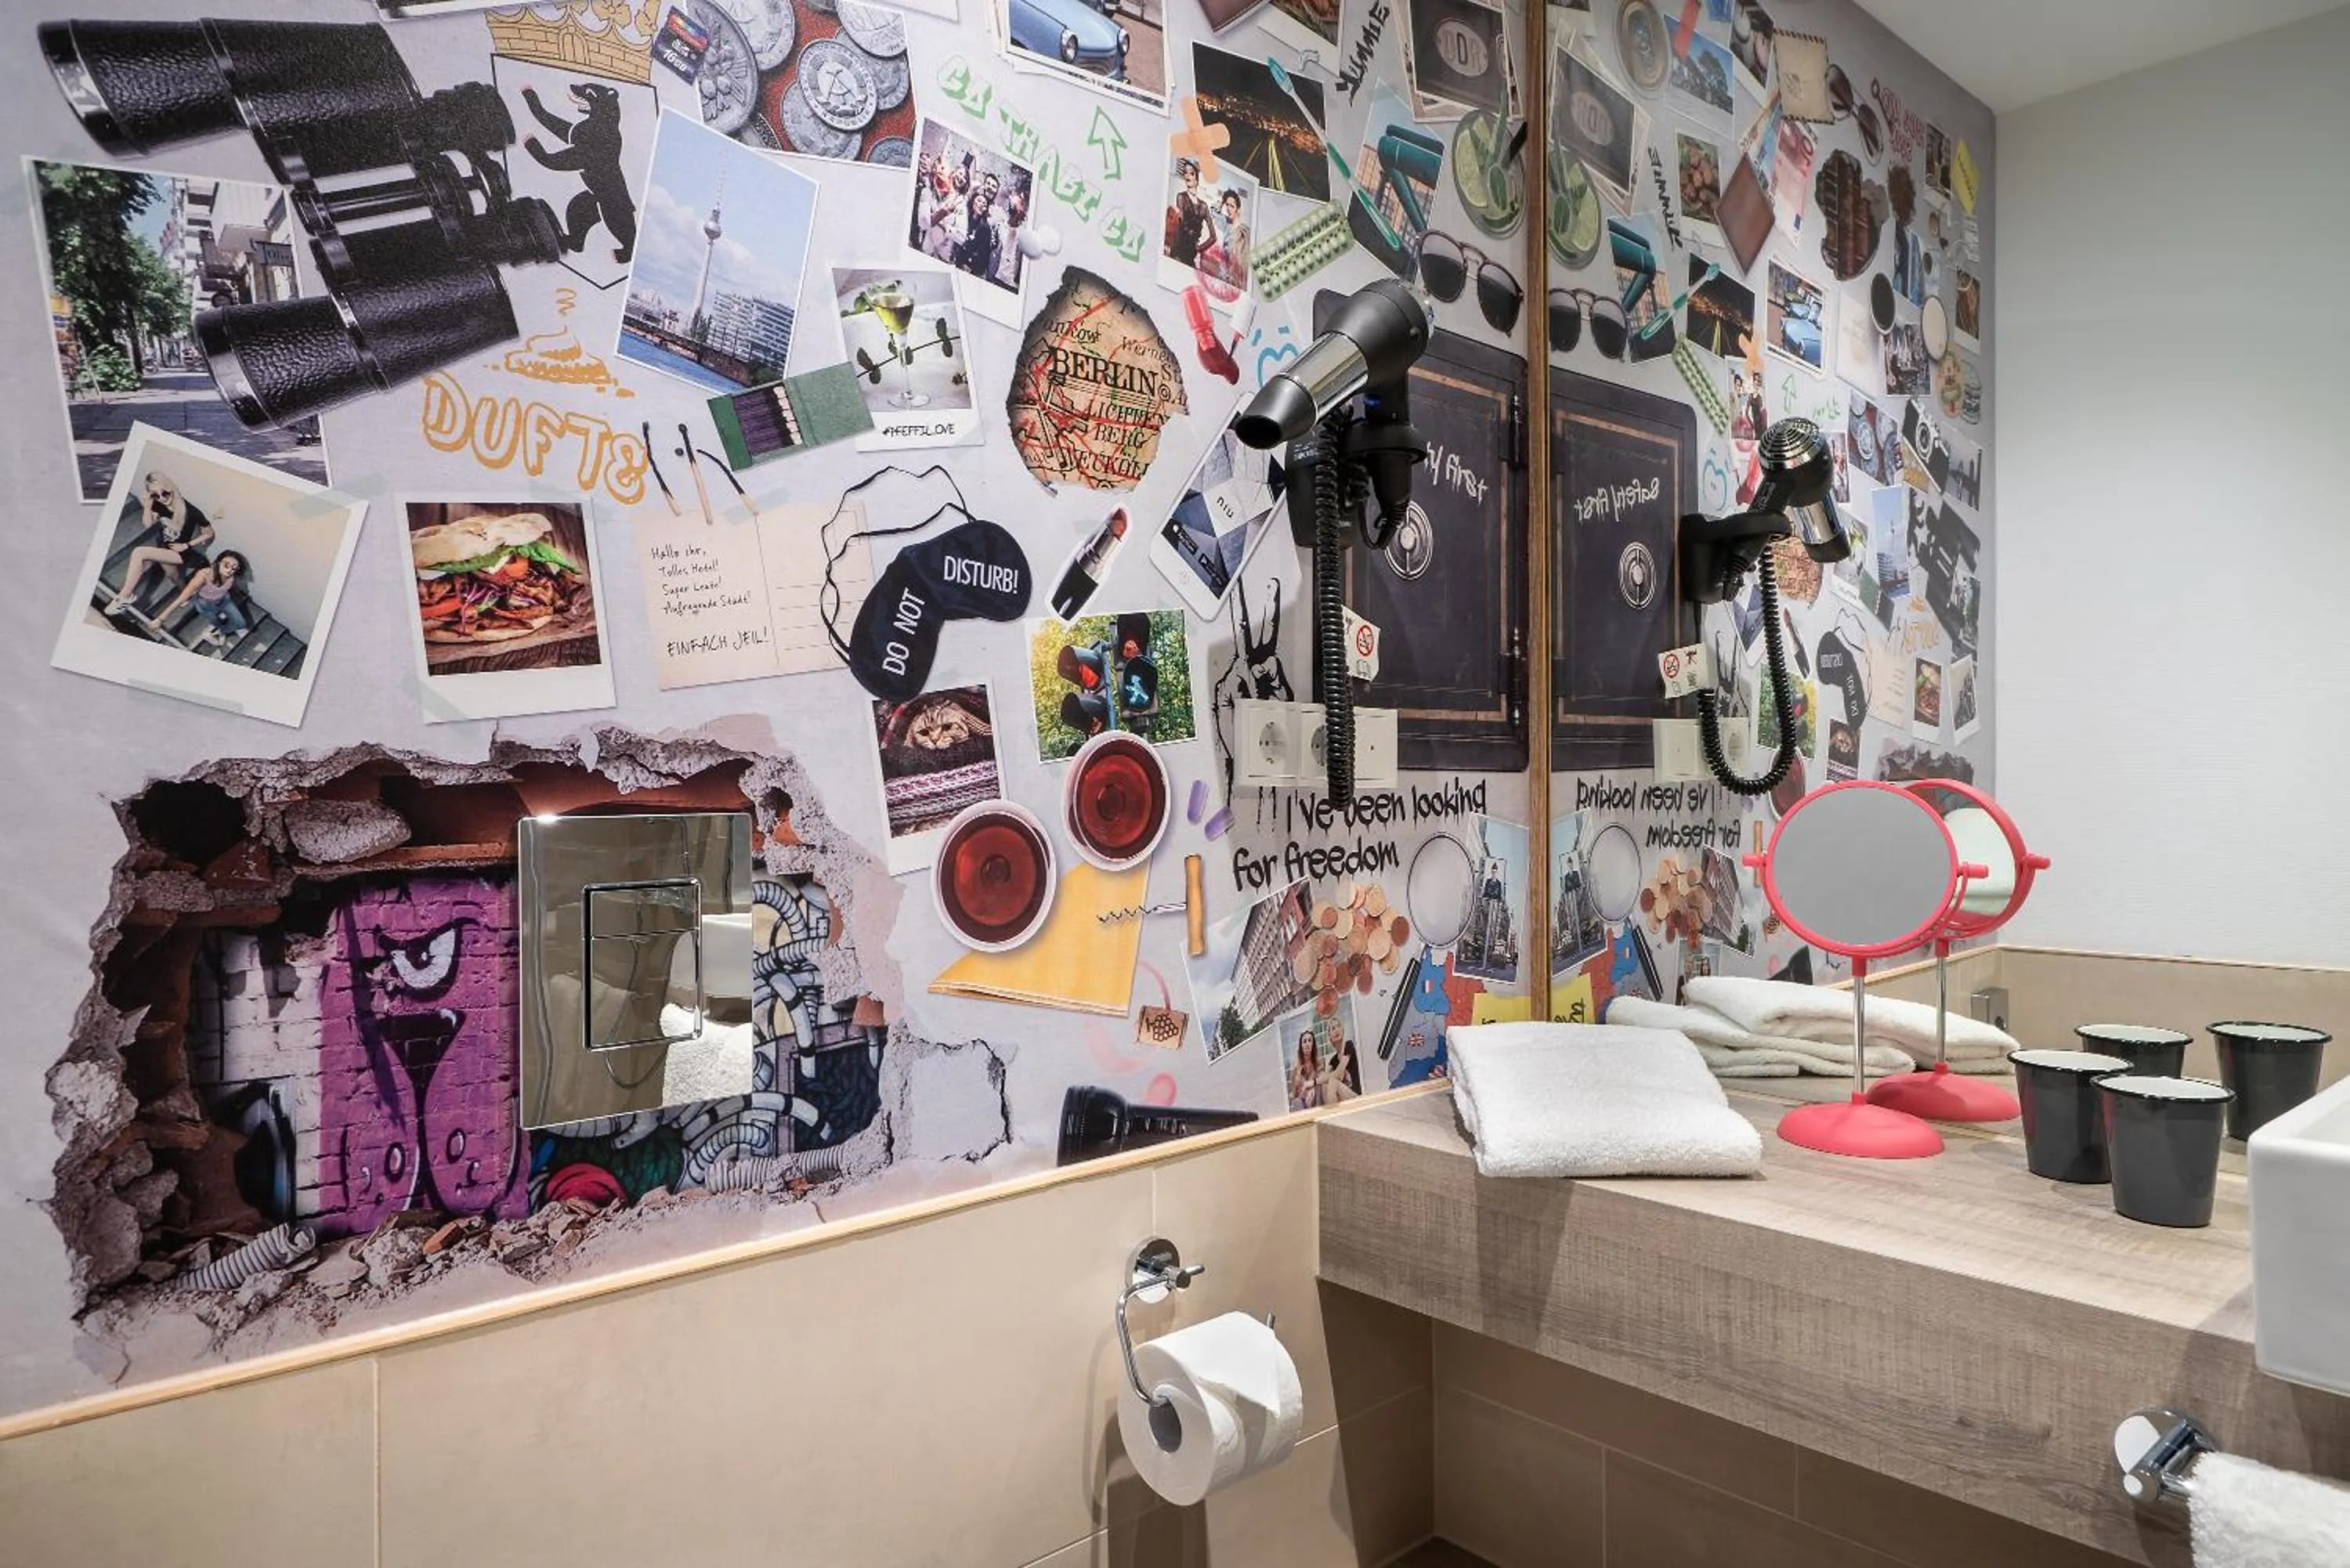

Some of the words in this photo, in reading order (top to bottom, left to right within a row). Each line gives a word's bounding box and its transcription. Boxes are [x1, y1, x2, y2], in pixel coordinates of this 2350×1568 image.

[1050, 345, 1158, 397] BERLIN
[652, 544, 679, 559] Hallo
[943, 555, 1018, 594] DISTURB!
[893, 587, 925, 635] NOT
[667, 635, 728, 656] EINFACH
[882, 641, 909, 676] DO
[1285, 789, 1334, 833] I've
[1411, 776, 1486, 826] looking
[1232, 846, 1278, 891] for
[1285, 835, 1401, 885] freedom
